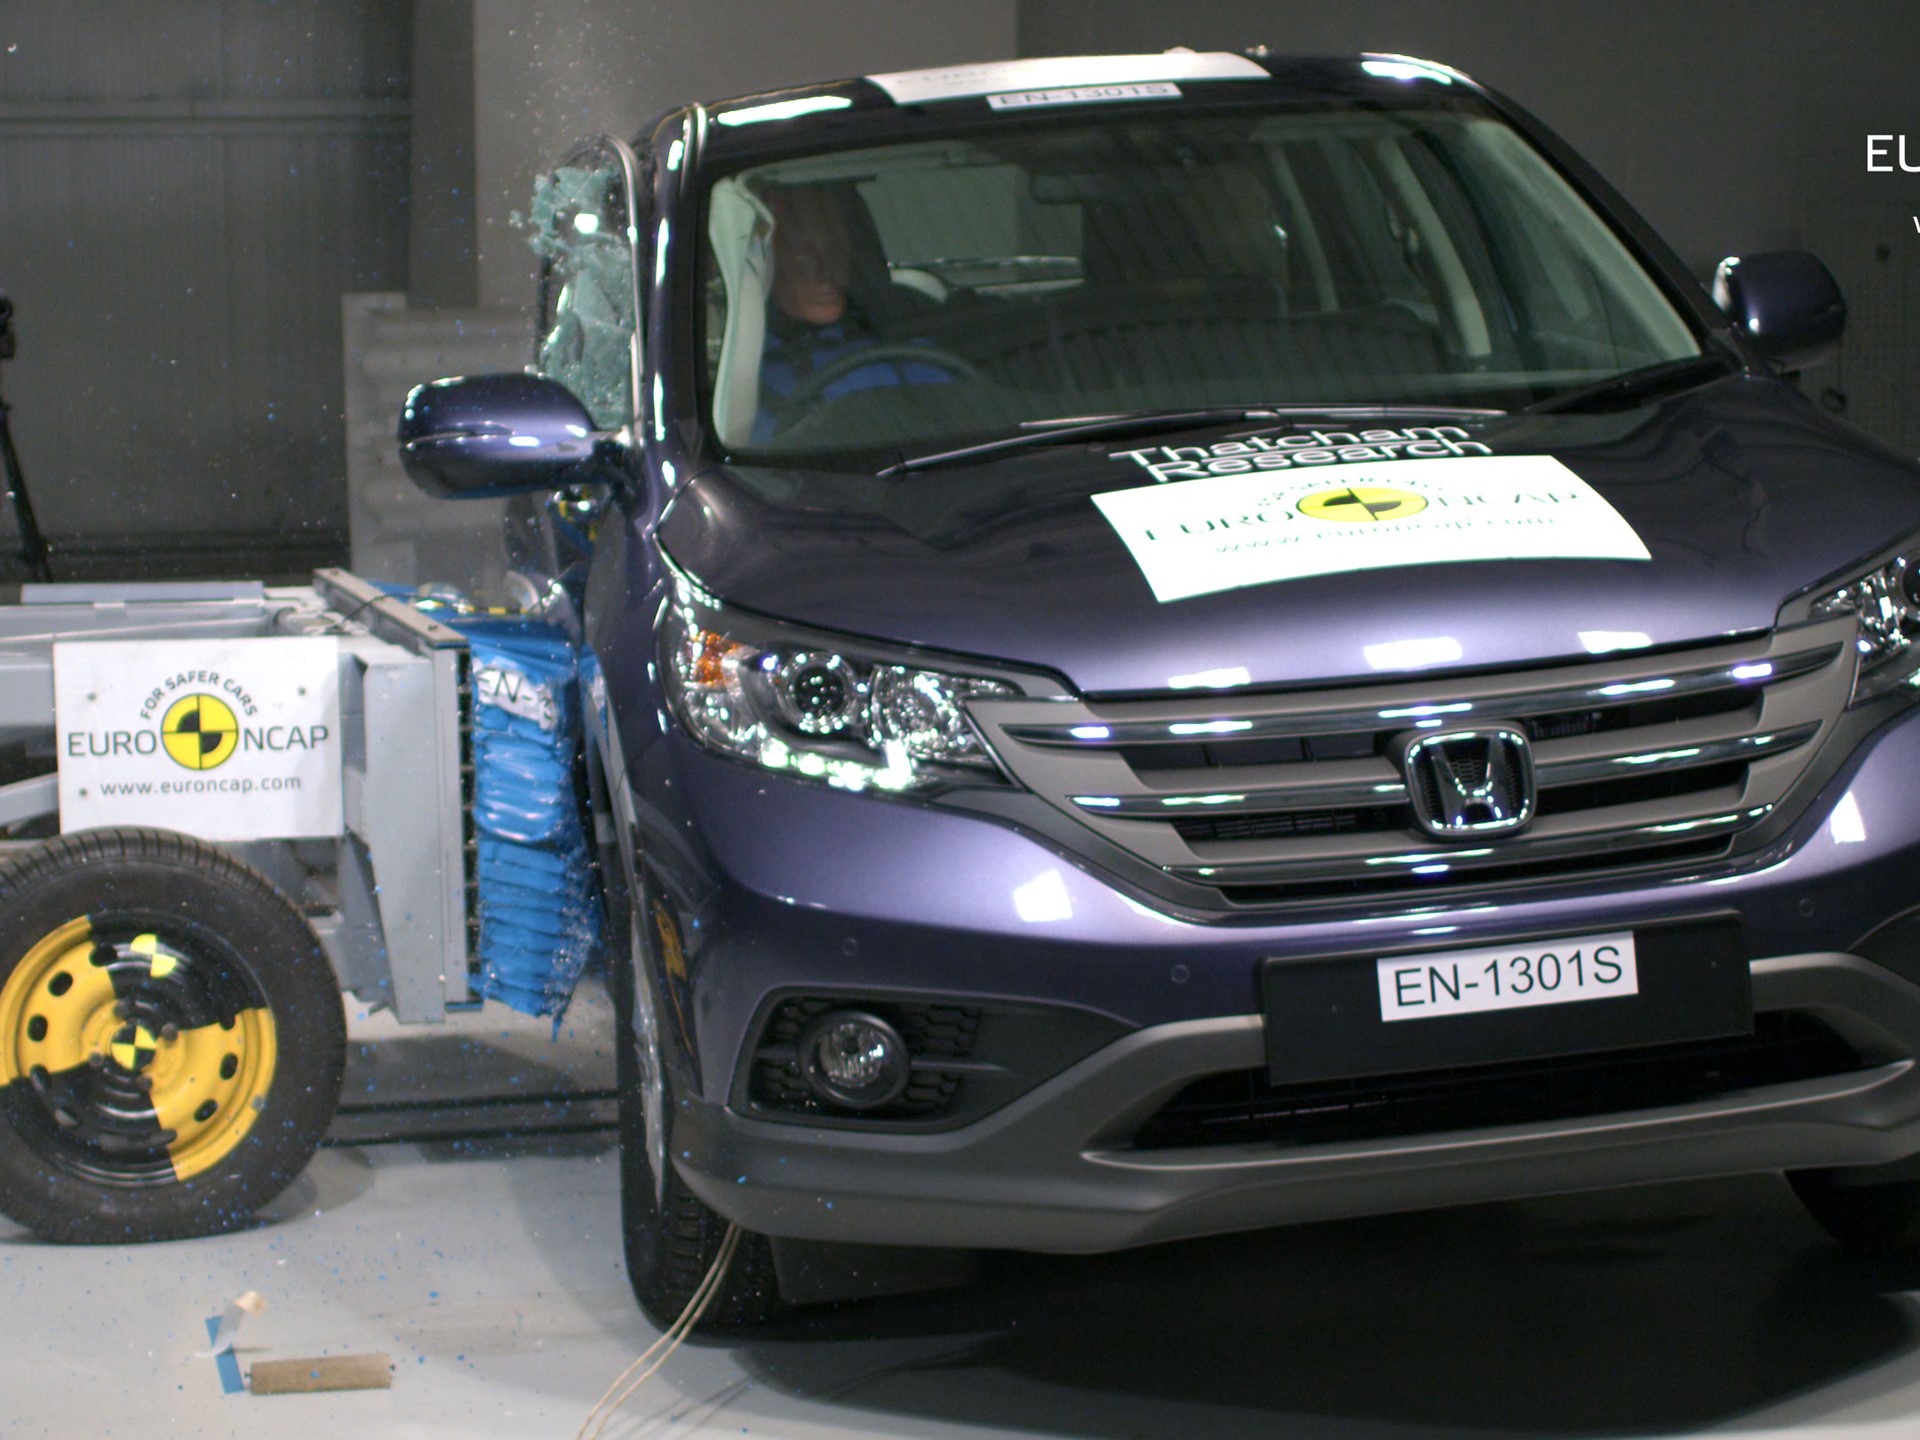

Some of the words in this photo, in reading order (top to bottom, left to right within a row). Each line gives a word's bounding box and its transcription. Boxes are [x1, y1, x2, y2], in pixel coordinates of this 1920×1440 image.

[1000, 84, 1168, 105] EN-1301S
[1109, 425, 1470, 467] Thatcham
[1147, 438, 1493, 483] Research
[139, 686, 166, 720] FOR
[164, 670, 220, 691] SAFER
[222, 678, 258, 717] CARS
[67, 730, 158, 757] EURO
[243, 724, 330, 751] NCAP
[99, 776, 302, 798] www.euroncap.com
[1394, 945, 1623, 1008] EN-1301S
